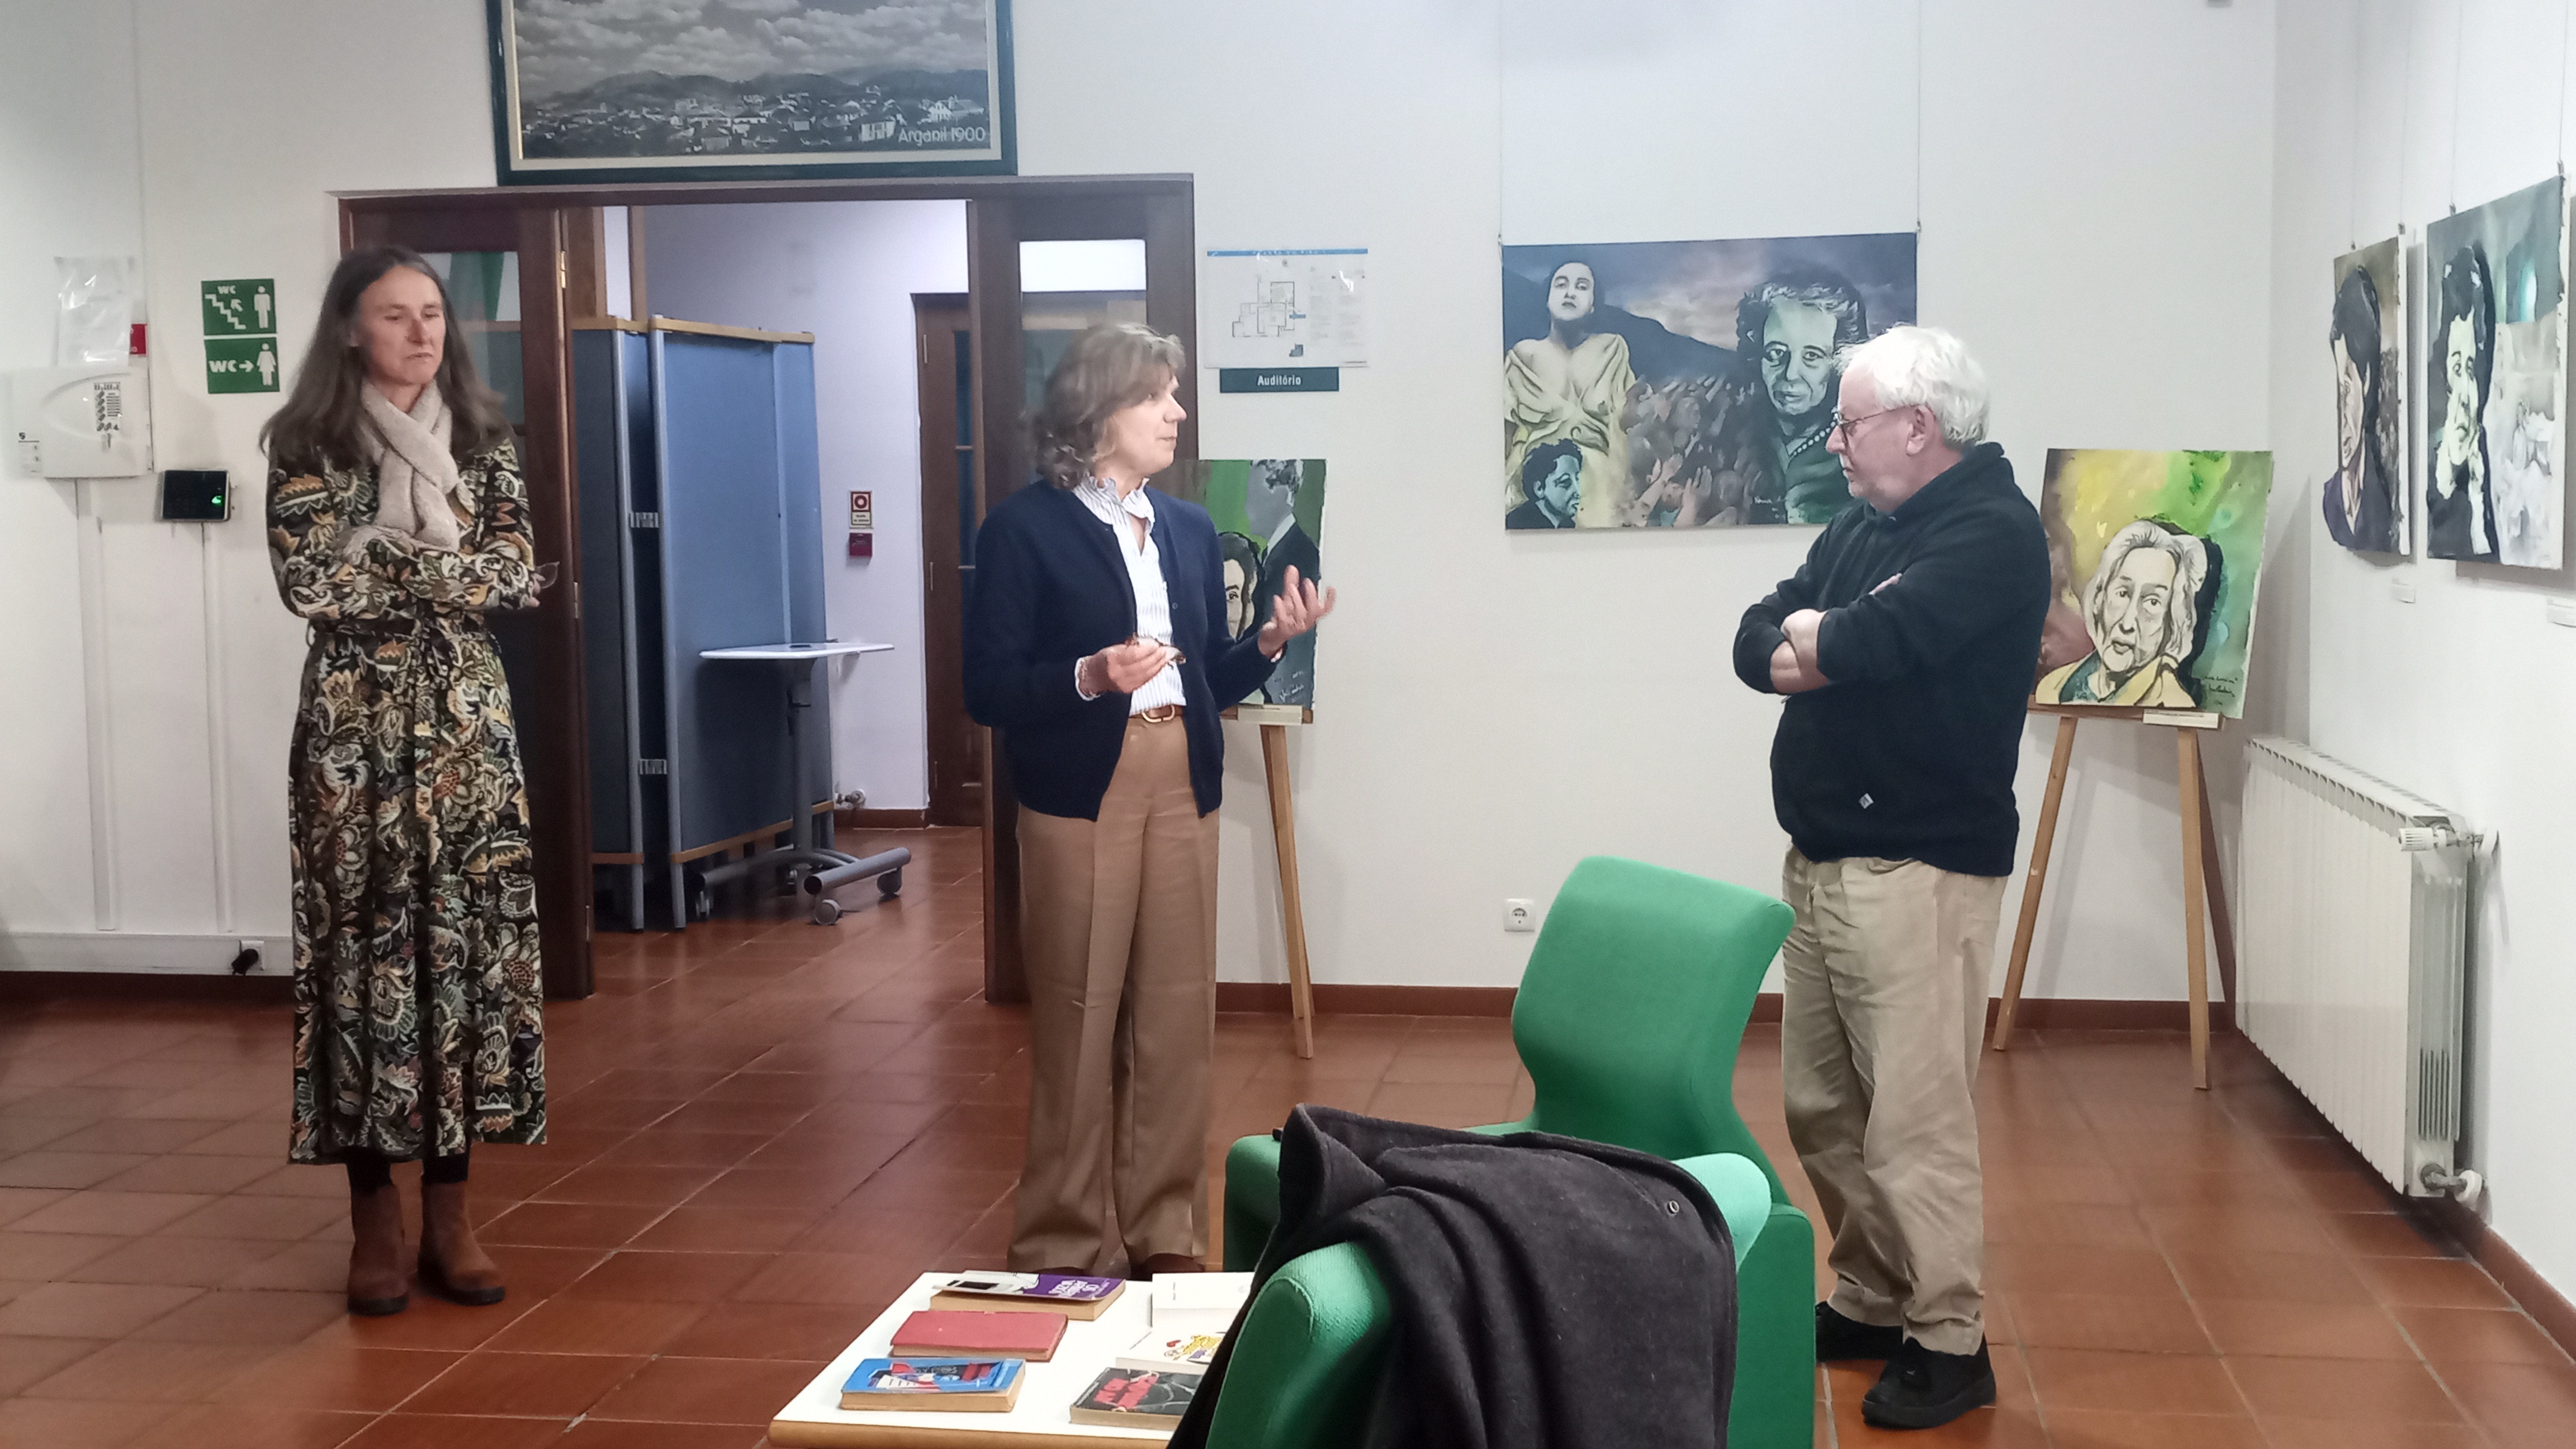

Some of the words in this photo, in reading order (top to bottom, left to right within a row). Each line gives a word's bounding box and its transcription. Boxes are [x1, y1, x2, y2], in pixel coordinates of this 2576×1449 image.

[898, 126, 946, 146] Arganil
[951, 126, 986, 142] 1900
[217, 285, 236, 295] WC
[209, 359, 237, 373] WC
[1257, 374, 1301, 386] Auditório
